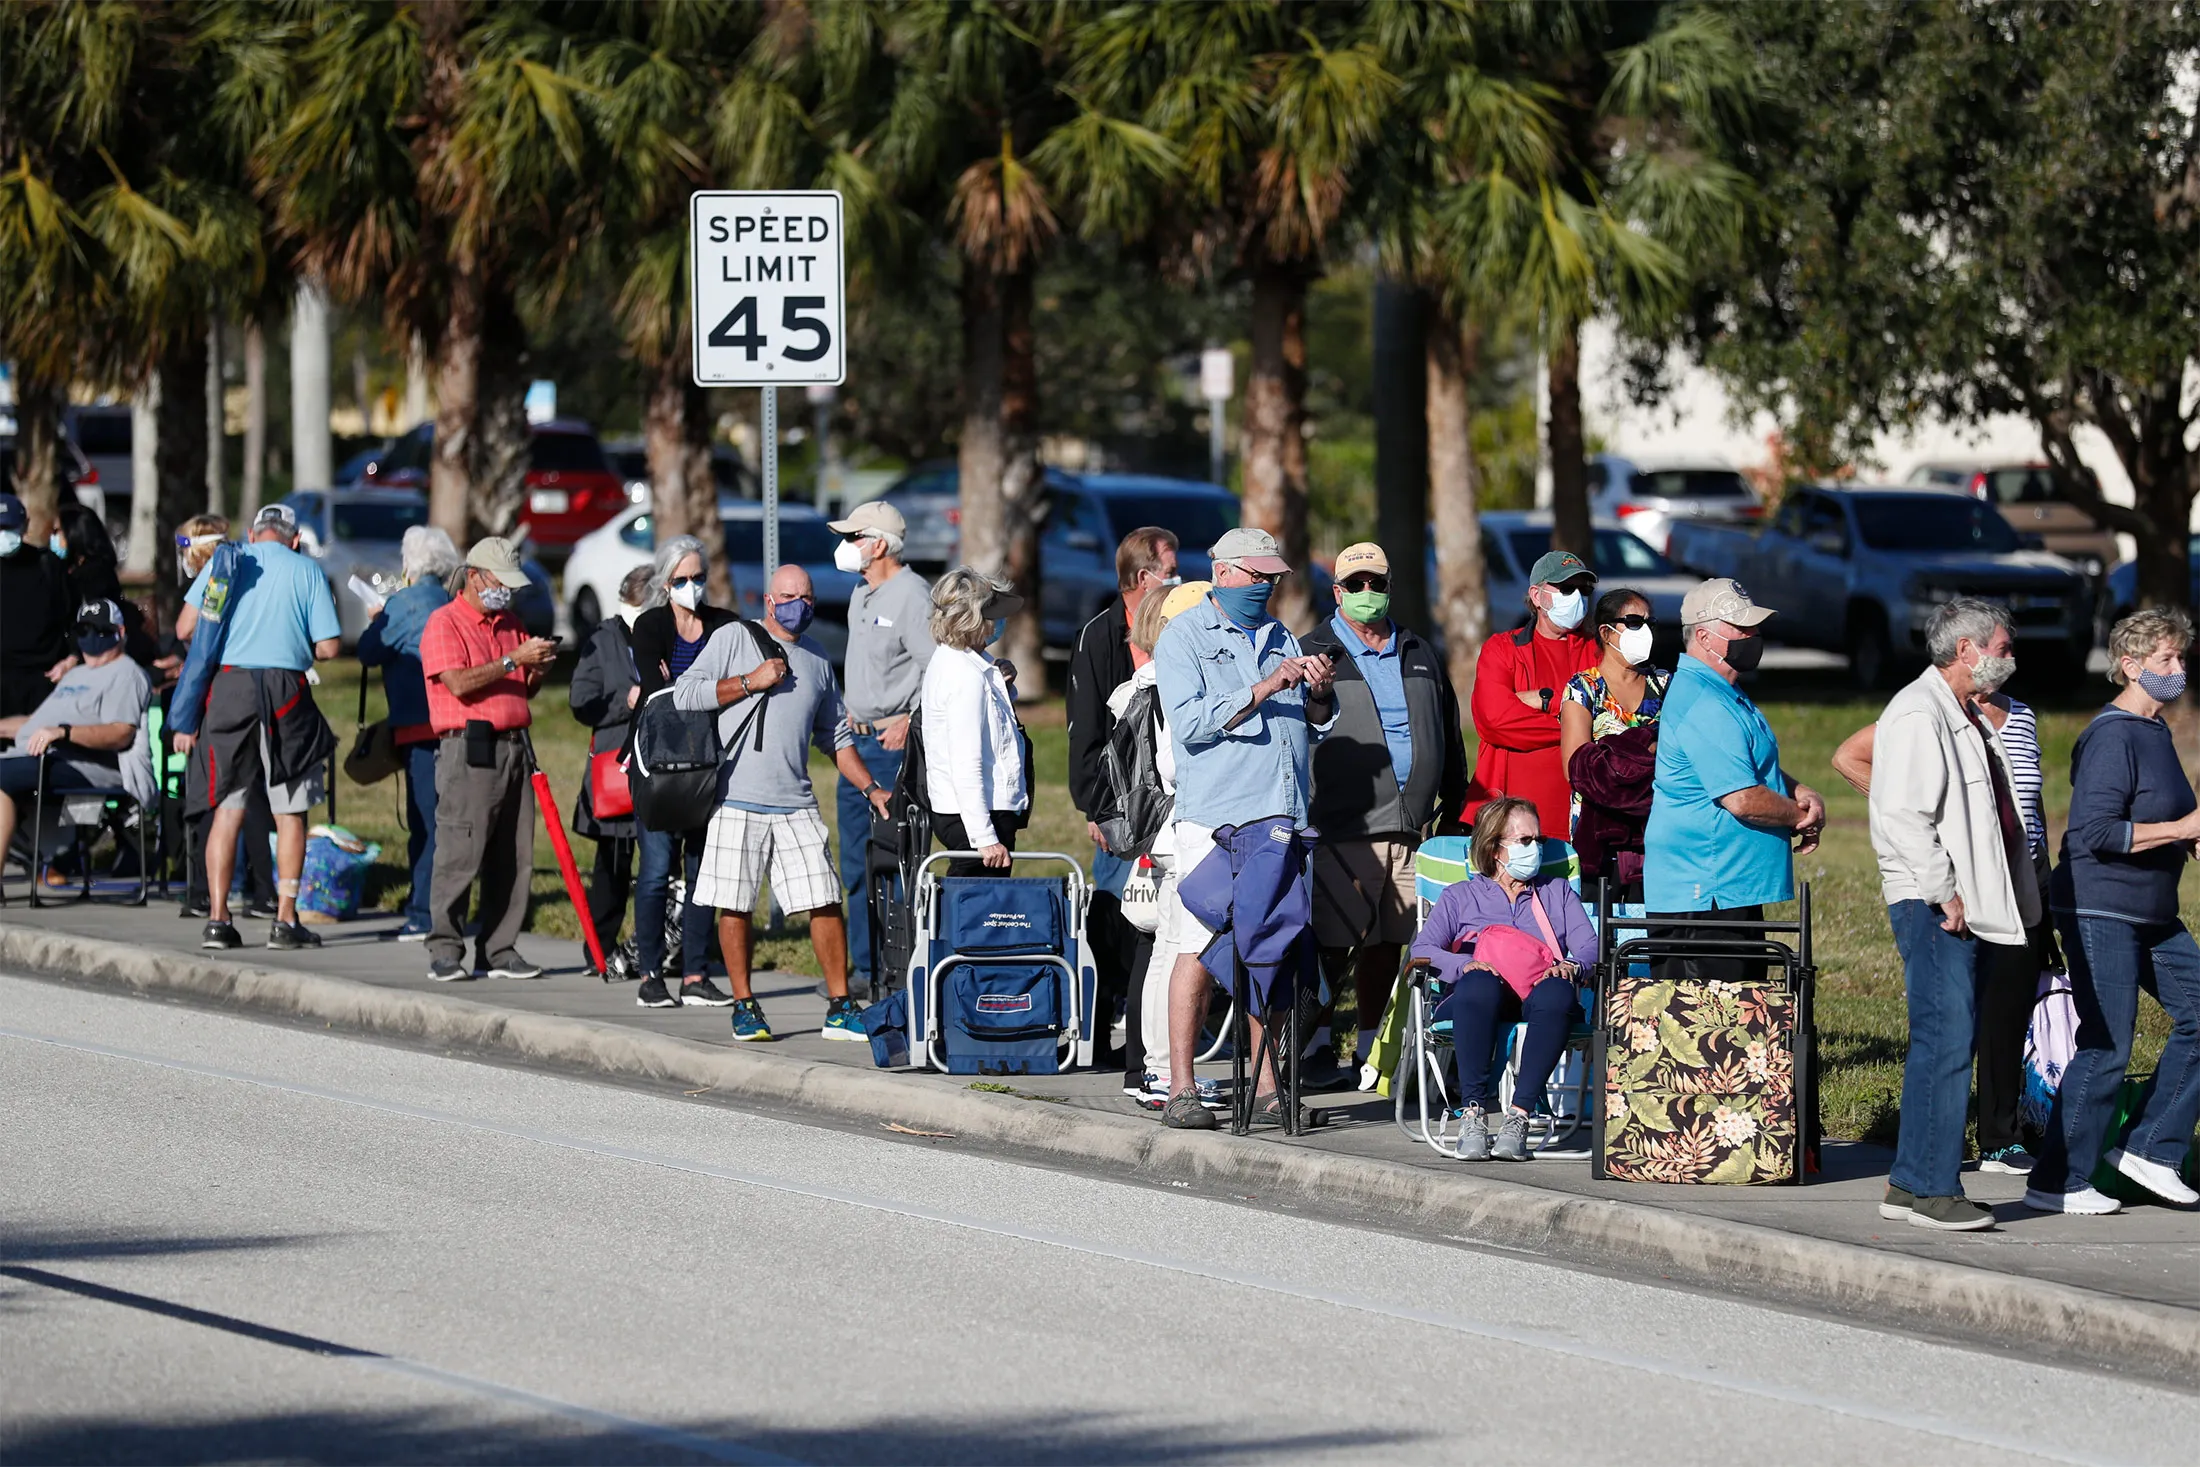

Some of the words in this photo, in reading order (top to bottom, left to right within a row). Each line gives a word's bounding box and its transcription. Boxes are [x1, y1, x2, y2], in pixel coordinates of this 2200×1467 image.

[709, 215, 829, 243] SPEED
[722, 255, 817, 282] LIMIT
[707, 296, 832, 362] 45
[982, 919, 998, 928] Spot
